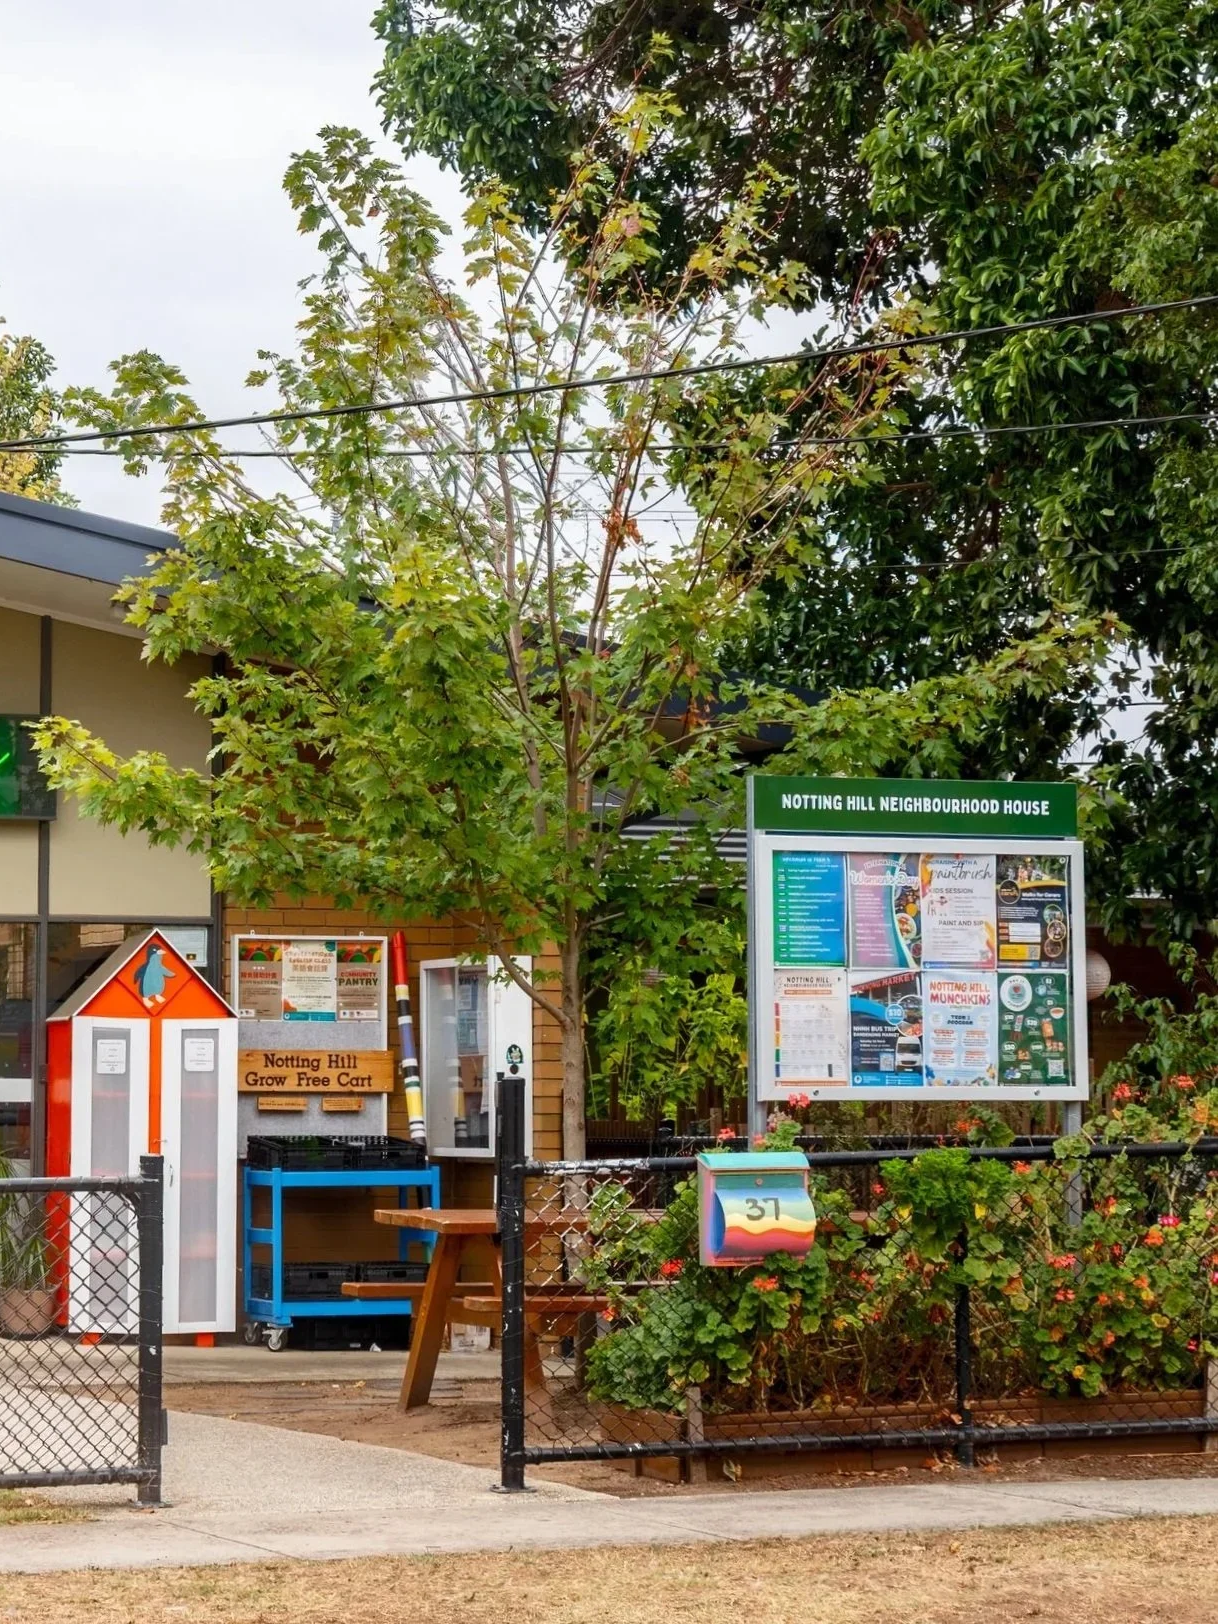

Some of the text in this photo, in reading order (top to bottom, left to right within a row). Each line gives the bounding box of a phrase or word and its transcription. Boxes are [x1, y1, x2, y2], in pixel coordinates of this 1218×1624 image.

[781, 793, 1050, 816] NOTTING HILL NEIGHBOURHOOD HOUSE
[338, 978, 379, 986] PANTRY
[929, 981, 991, 993] NOTTING HILL
[929, 993, 991, 1006] MUNCHKINS
[888, 1008, 902, 1017] $10
[264, 1053, 358, 1071] Notting Hill
[245, 1071, 373, 1087] Grow Free Cart
[745, 1197, 781, 1222] 37
